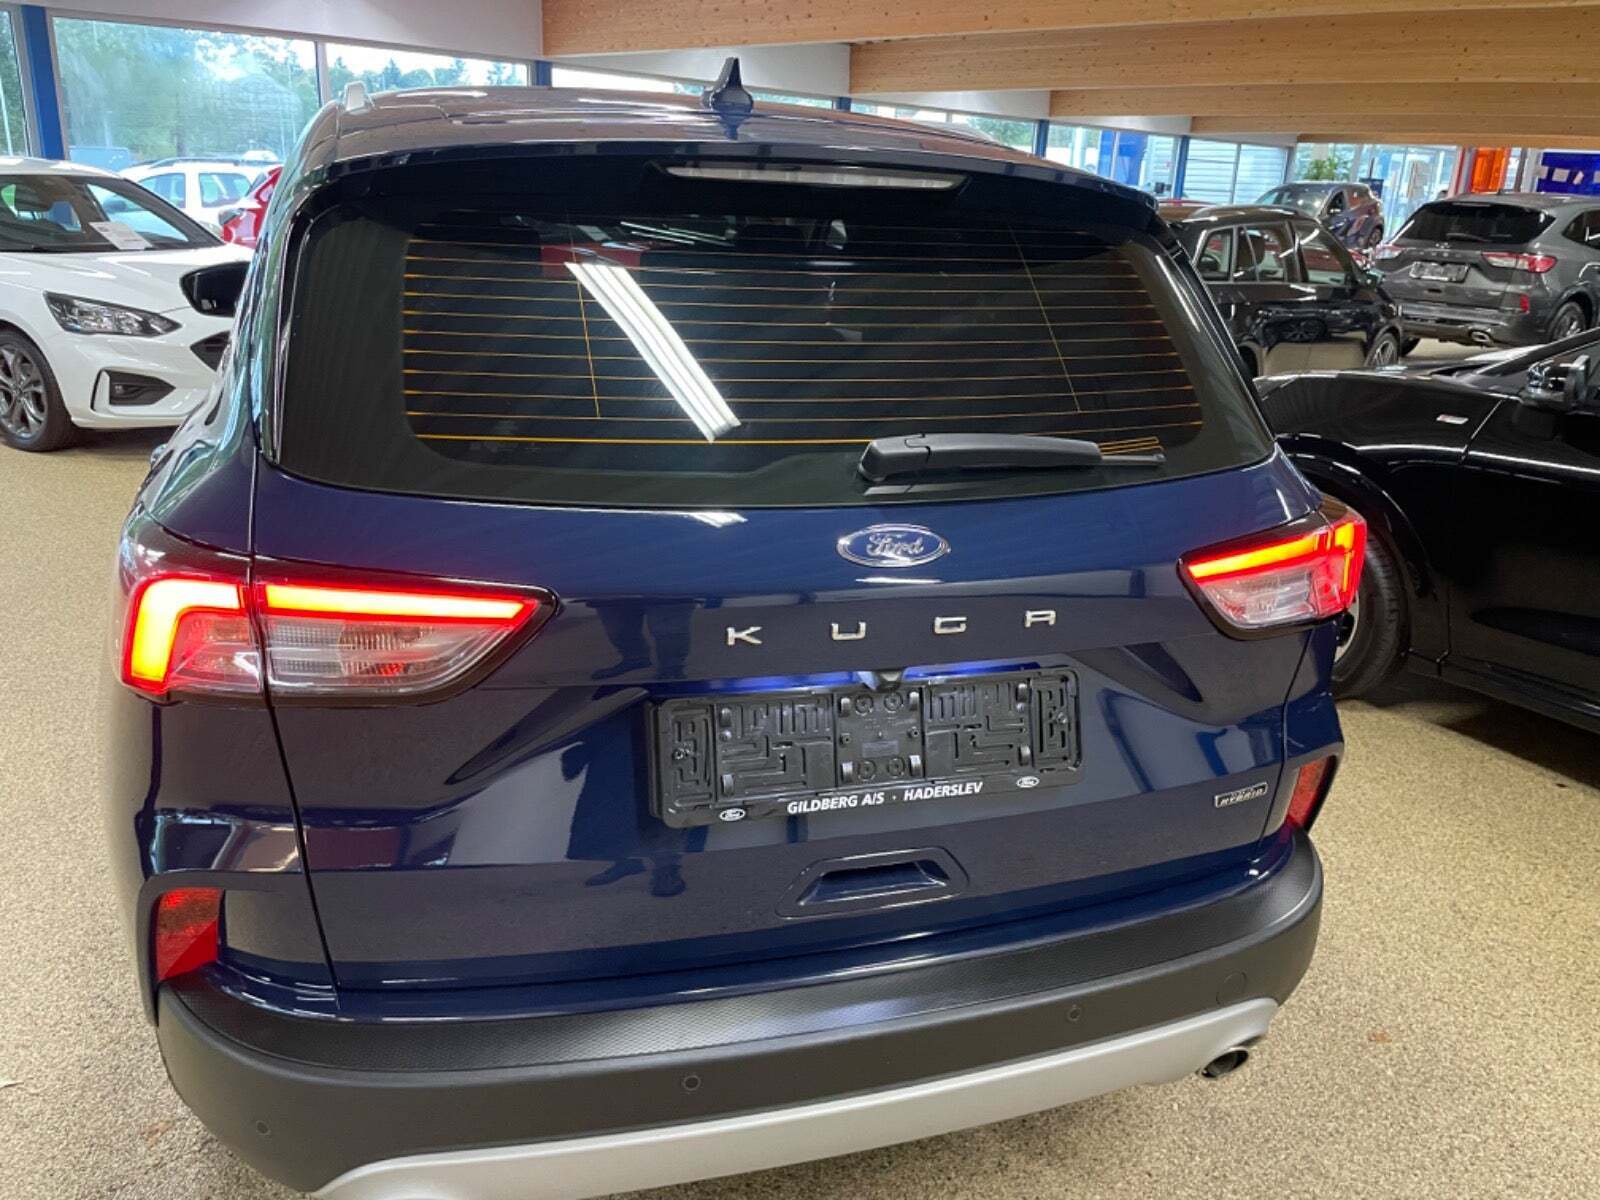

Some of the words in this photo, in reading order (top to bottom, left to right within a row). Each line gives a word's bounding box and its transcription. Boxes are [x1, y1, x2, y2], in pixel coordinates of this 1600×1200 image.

[866, 532, 924, 557] Ford
[727, 610, 1056, 645] KUGA
[787, 795, 858, 814] GILDBERG
[861, 792, 885, 806] A/S
[904, 781, 984, 801] HADERSLEV
